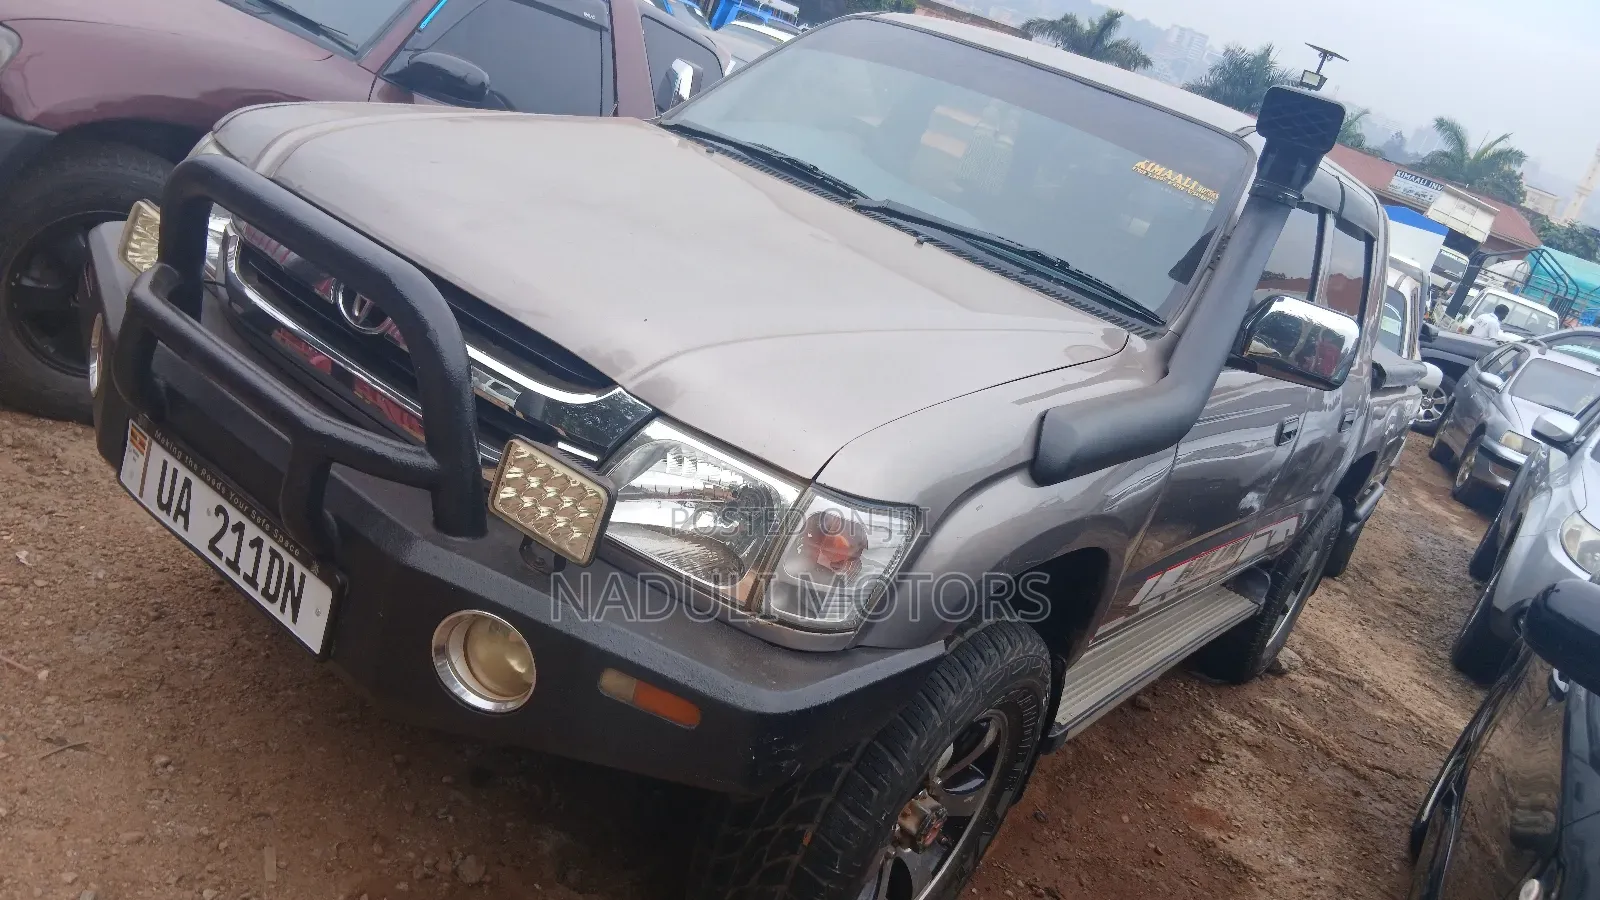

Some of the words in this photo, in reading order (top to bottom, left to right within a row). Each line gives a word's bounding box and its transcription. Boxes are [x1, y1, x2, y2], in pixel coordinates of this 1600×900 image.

[1134, 159, 1199, 190] KIMAALI
[1396, 170, 1427, 186] KIMAALI
[154, 429, 182, 460] Making
[185, 454, 199, 472] the
[229, 487, 249, 513] Your
[273, 528, 300, 557] Space
[156, 459, 193, 532] UA
[207, 504, 306, 626] 211DN
